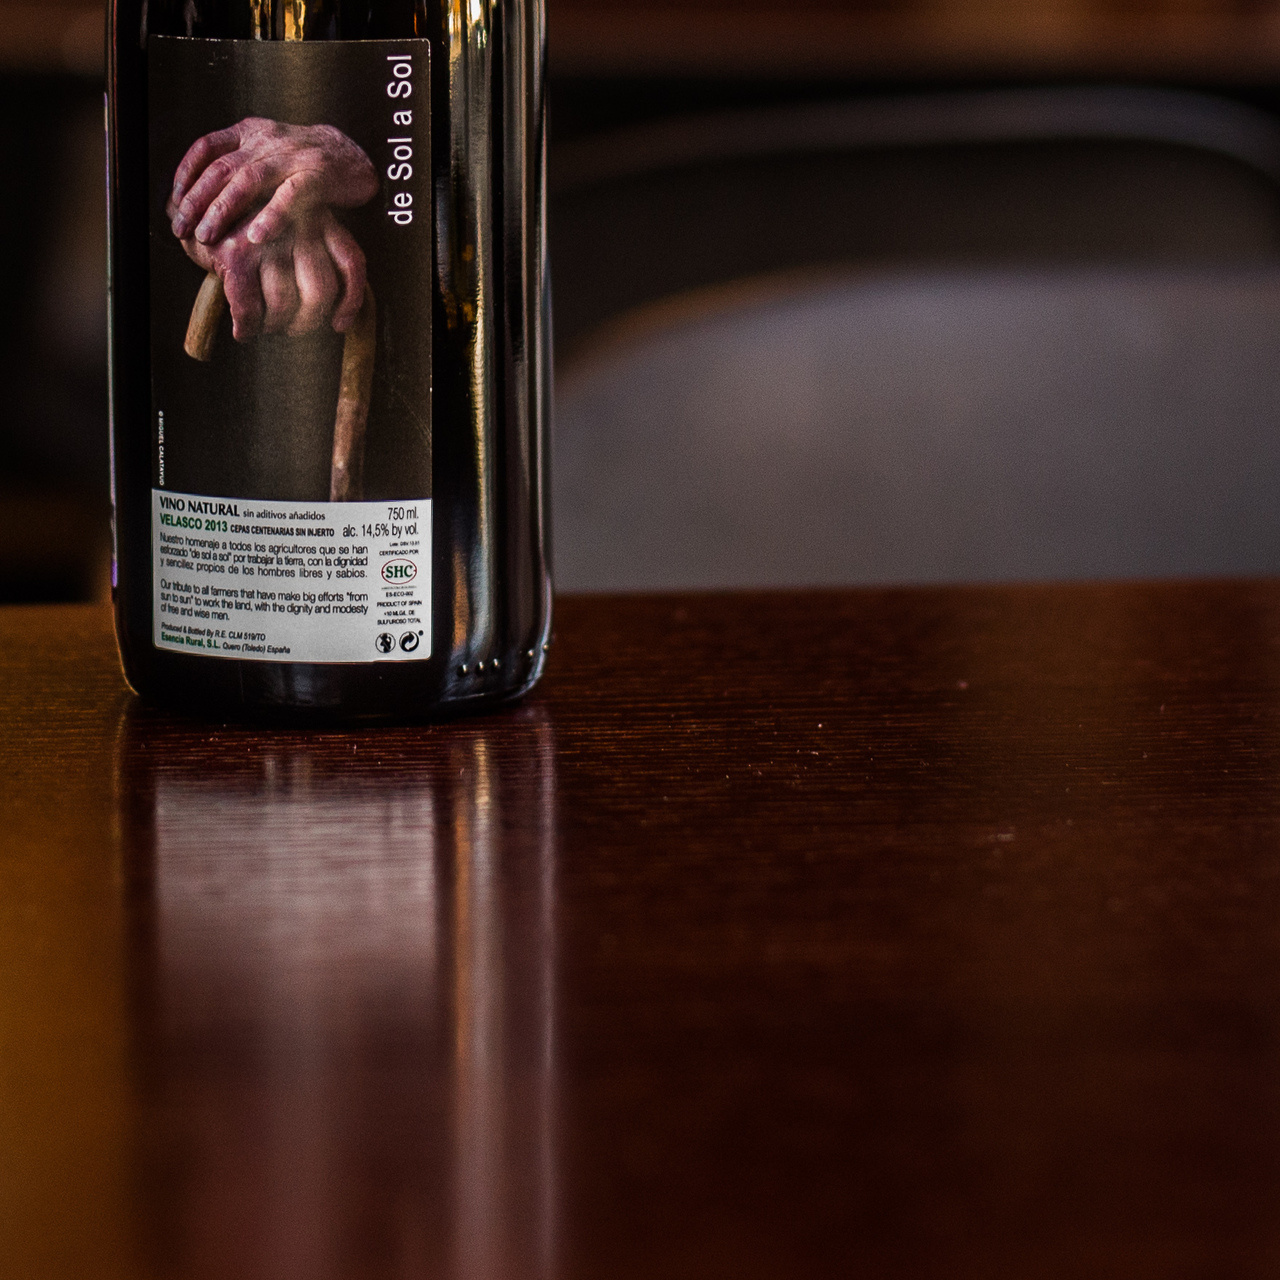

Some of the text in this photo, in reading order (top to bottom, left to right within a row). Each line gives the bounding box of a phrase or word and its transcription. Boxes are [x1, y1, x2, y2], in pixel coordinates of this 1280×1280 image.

[386, 55, 413, 225] de Sol a Sol
[160, 496, 326, 521] VINO NATURAL sin aditivos añadidos
[388, 506, 419, 521] 750 ml.
[160, 513, 335, 537] VELASCO 2013 CEPAS CENTENARIAS SIN INJERTO
[342, 522, 419, 539] alc. 14,5% by vol.
[160, 532, 184, 545] Nuestro
[185, 536, 220, 551] homenaje
[229, 541, 252, 551] todos
[254, 543, 266, 553] los
[268, 544, 317, 555] agricultores
[319, 545, 336, 555] que
[338, 546, 350, 554] se
[352, 544, 369, 554] han
[201, 551, 213, 561] sol
[233, 554, 246, 564] por
[247, 554, 275, 567] trabajar
[276, 556, 283, 564] la
[307, 558, 324, 566] con
[325, 557, 332, 566] la
[333, 556, 369, 568] dignidad
[166, 560, 194, 571] sencillez
[196, 563, 225, 574] propios
[228, 565, 239, 575] de
[242, 566, 255, 576] los
[257, 567, 296, 578] hombres
[299, 569, 323, 578] libres
[326, 570, 333, 581] y
[335, 568, 368, 579] sabios.
[385, 564, 414, 579] SHC
[160, 578, 171, 589] Our
[172, 582, 192, 593] tribute
[193, 584, 201, 595] to
[201, 585, 210, 596] all
[211, 586, 239, 598] farmers
[240, 589, 255, 599] that
[256, 590, 276, 600] have
[278, 590, 301, 601] make
[303, 591, 316, 604] big
[318, 591, 344, 602] efforts
[160, 604, 230, 621] of free and wise men.
[172, 593, 179, 602] to
[194, 596, 202, 606] to
[202, 598, 220, 608] work
[221, 599, 234, 610] the
[235, 601, 253, 612] land,
[254, 602, 271, 612] with
[272, 602, 286, 613] the
[287, 603, 313, 615] dignity
[314, 603, 331, 613] and
[332, 604, 369, 615] modesty
[161, 622, 182, 633] Produced
[188, 627, 206, 637] Bottled
[206, 629, 214, 639] By
[228, 632, 243, 640] CLM
[161, 632, 185, 645] Esencia
[185, 636, 206, 648] Rural,
[206, 640, 221, 649] S.L.
[242, 643, 266, 654] (Toledo)
[267, 645, 291, 655] España
